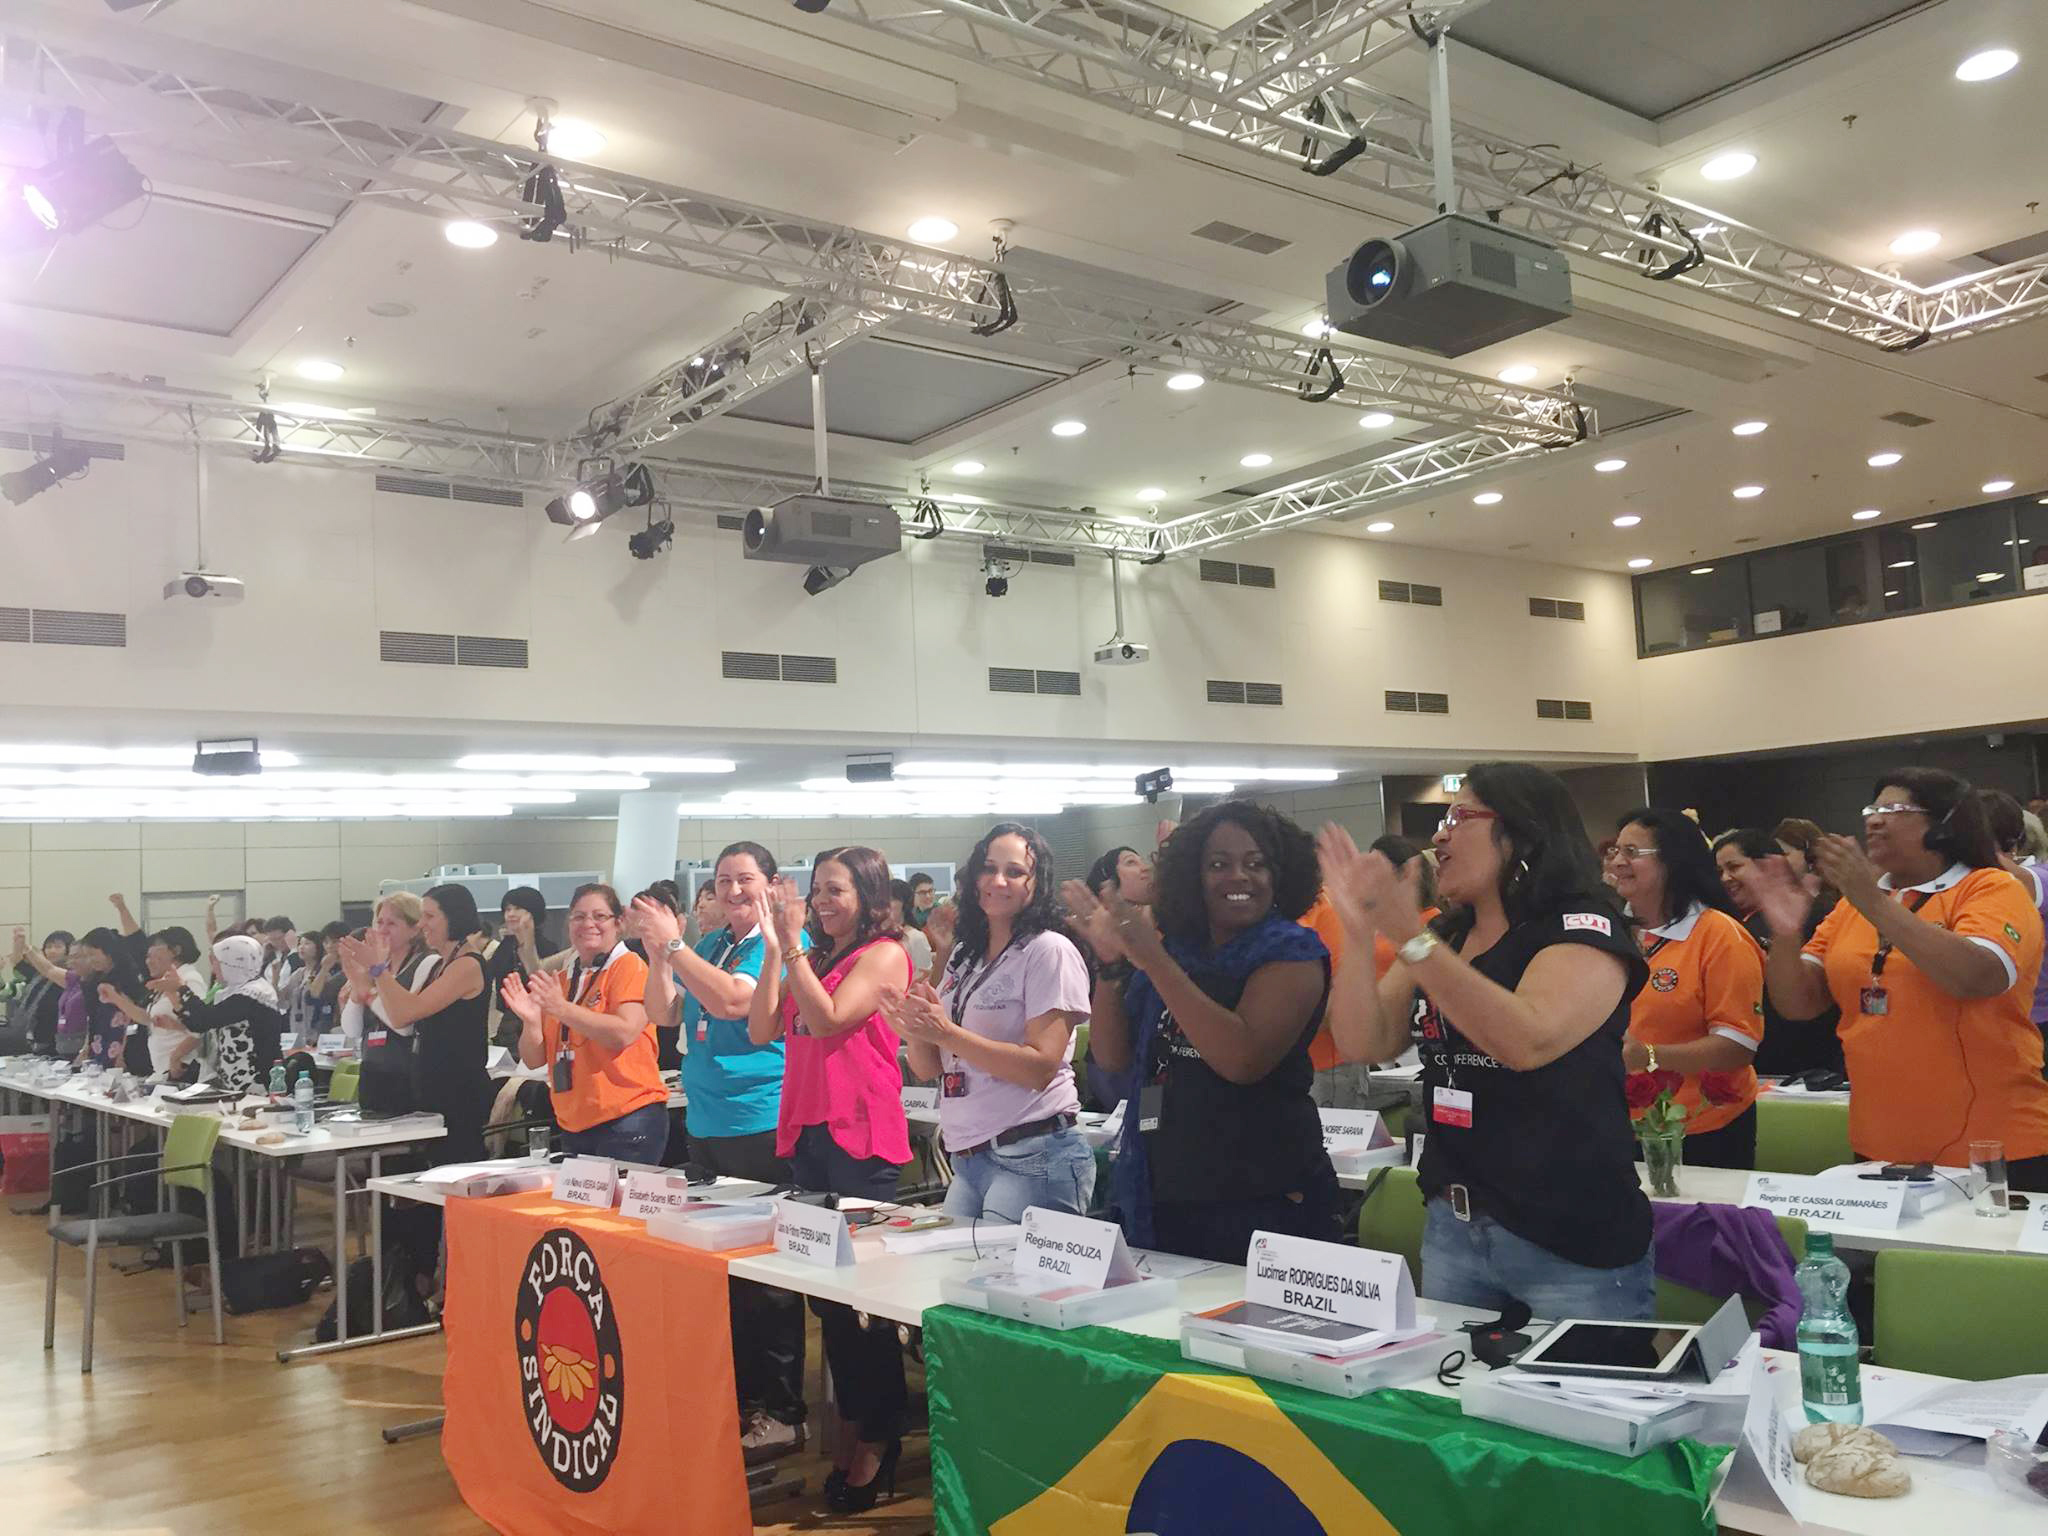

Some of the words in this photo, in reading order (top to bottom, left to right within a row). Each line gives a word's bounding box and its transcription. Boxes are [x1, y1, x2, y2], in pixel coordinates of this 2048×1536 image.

[1566, 914, 1607, 931] CUT
[567, 1190, 591, 1202] BRAZIL
[667, 1195, 682, 1206] MELO
[1760, 1193, 1787, 1204] Regina
[1788, 1195, 1800, 1204] DE
[1802, 1196, 1834, 1206] CASSIA
[1835, 1198, 1889, 1209] GUIMARÃES
[1788, 1208, 1845, 1220] BRAZIL
[789, 1239, 811, 1256] BRAZIL
[1025, 1232, 1064, 1251] Regiane
[1065, 1241, 1102, 1261] SOUZA
[1038, 1256, 1071, 1275] BRAZIL
[527, 1236, 604, 1331] FORÇA
[1257, 1261, 1288, 1283] Lucimar
[1289, 1267, 1339, 1294] RODRIGUES
[1340, 1278, 1354, 1296] DA
[1355, 1280, 1381, 1302] SILVA
[1283, 1290, 1337, 1314] BRAZIL
[522, 1354, 618, 1480] SINDICAL
